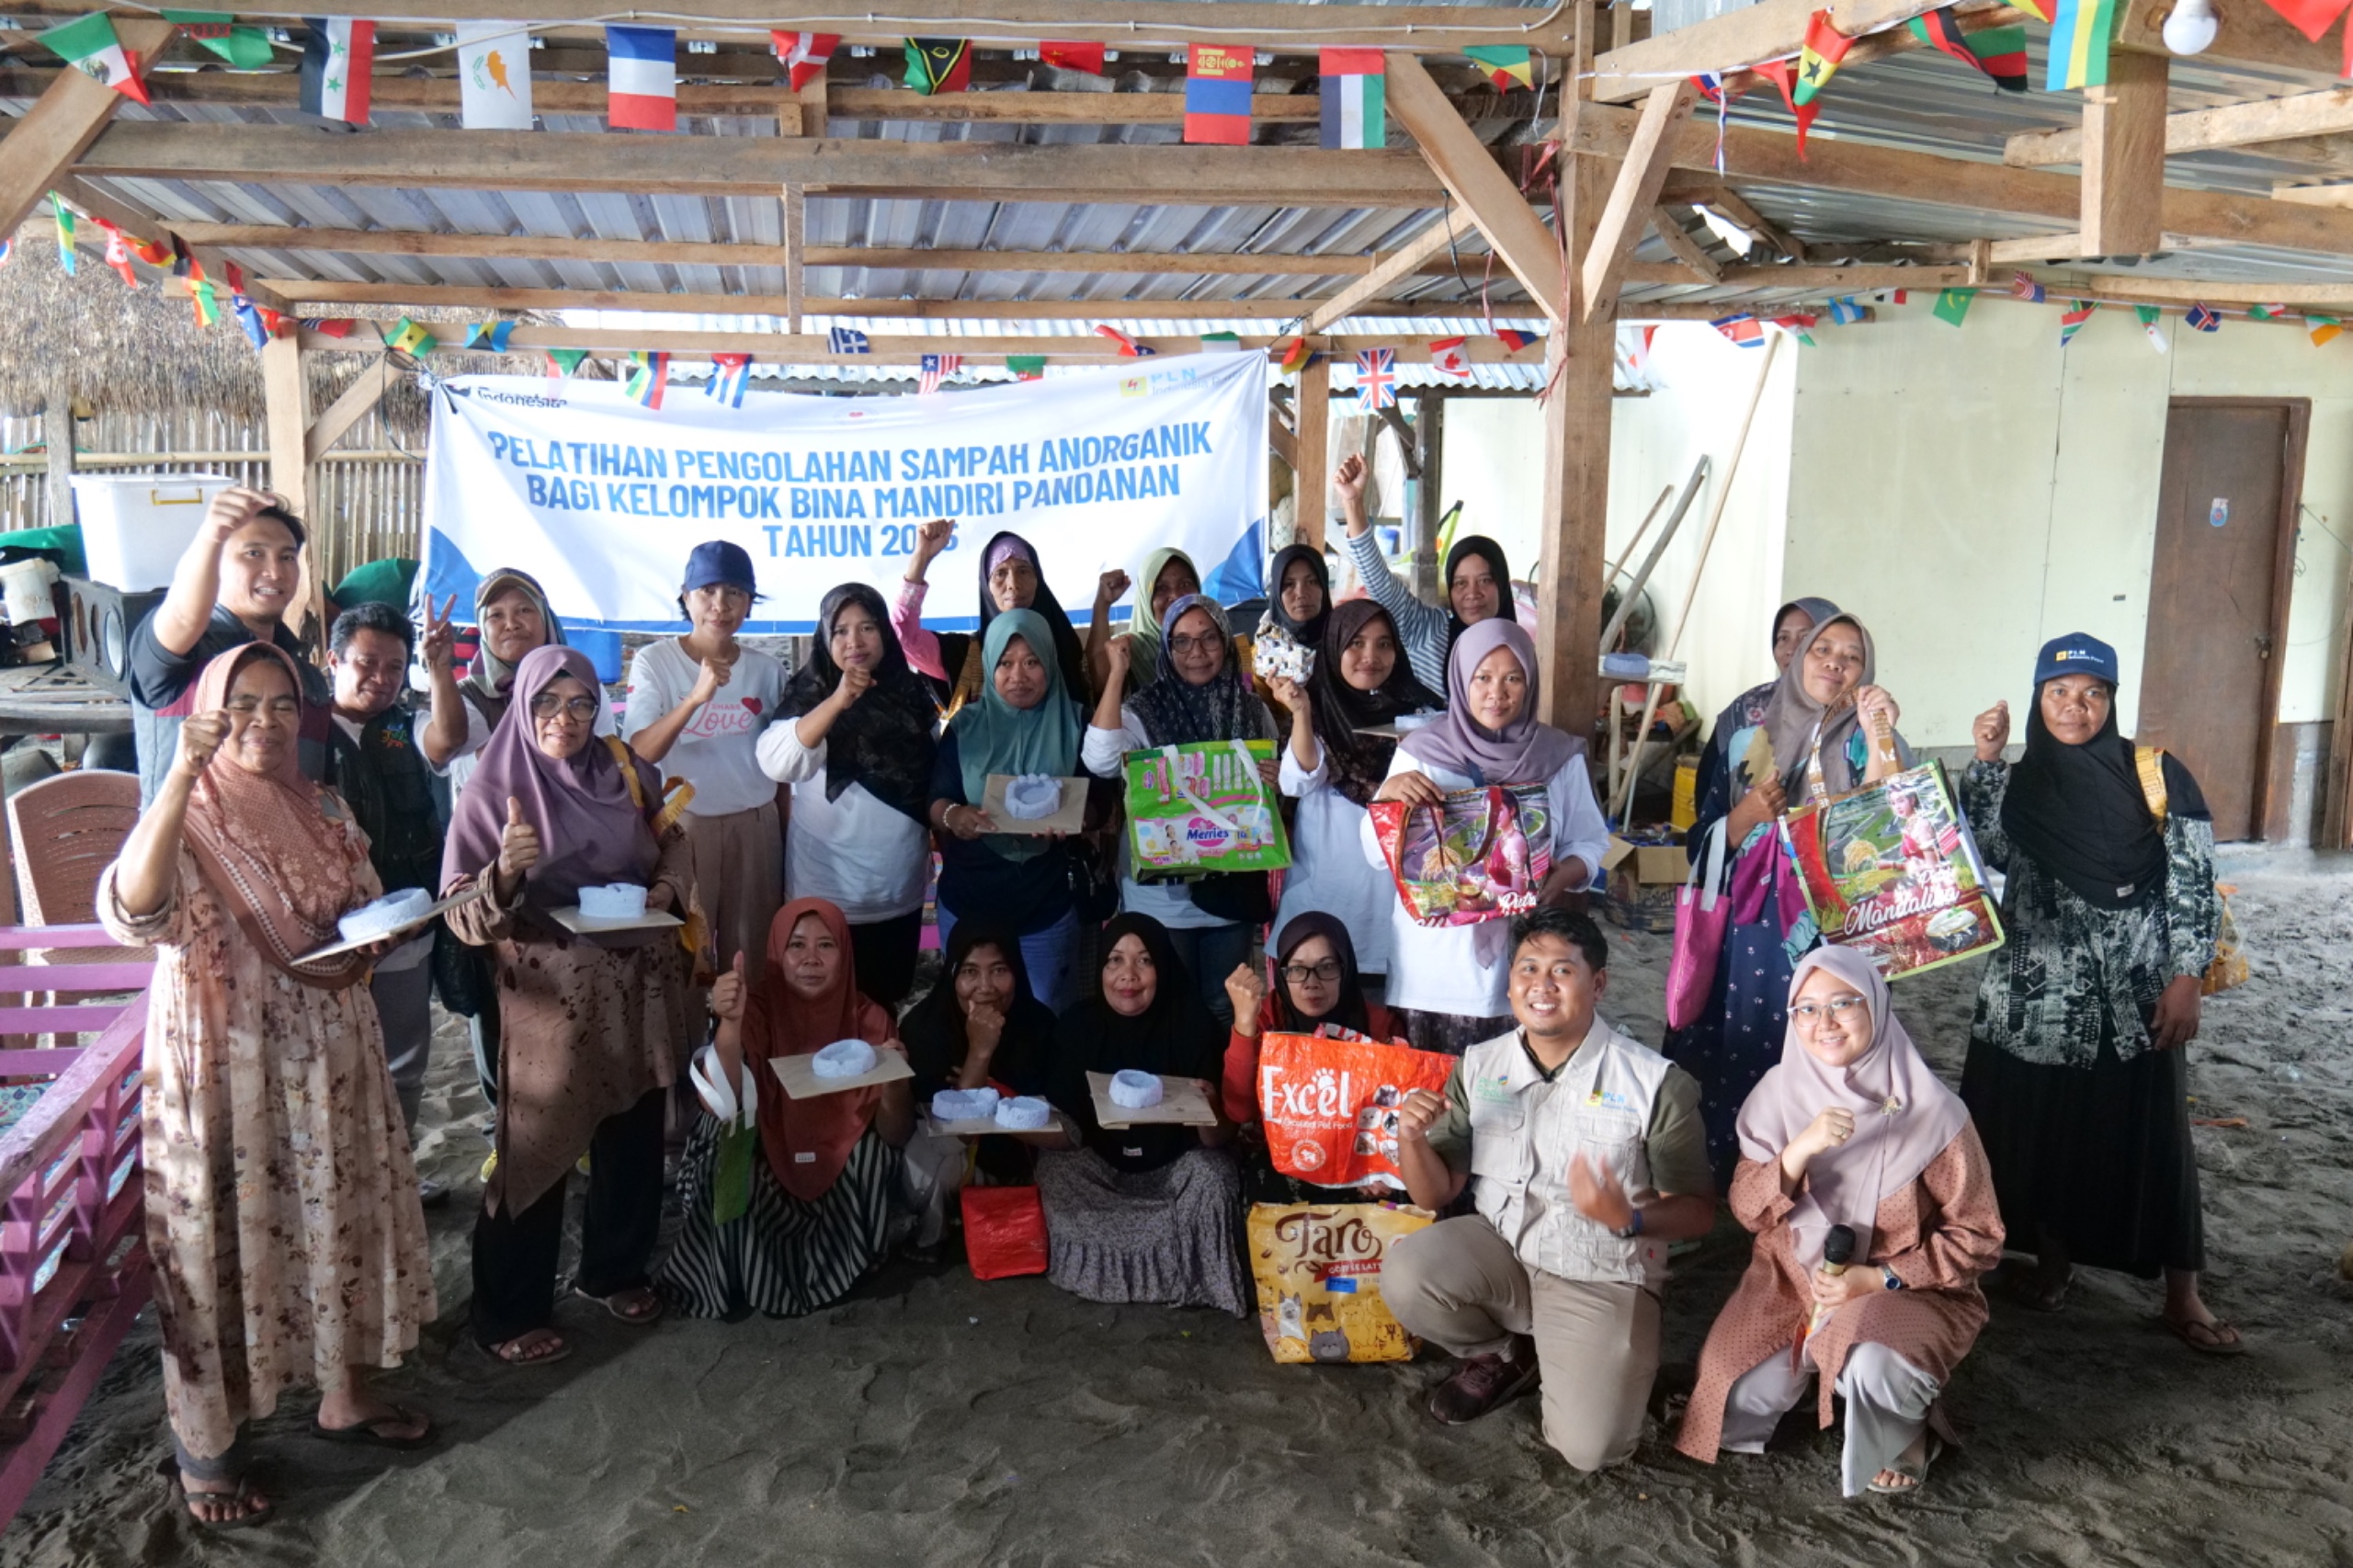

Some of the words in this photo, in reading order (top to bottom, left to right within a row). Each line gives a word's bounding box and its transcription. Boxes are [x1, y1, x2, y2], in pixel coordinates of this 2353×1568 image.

[1151, 368, 1197, 382] PLN
[488, 431, 667, 478] PELATIHAN
[675, 449, 892, 483] PENGOLAHAN
[901, 443, 1029, 481] SAMPAH
[1038, 421, 1212, 472] ANORGANIK
[526, 473, 600, 510] BAGI
[607, 483, 781, 518] KELOMPOK
[790, 486, 867, 518] BINA
[875, 482, 1004, 518] MANDIRI
[1013, 464, 1181, 511] PANDANAN
[762, 525, 872, 557] TAHUN
[682, 700, 754, 737] Love
[1186, 827, 1230, 840] Merries
[1262, 1065, 1353, 1124] Excel
[1275, 1209, 1382, 1261] Taro
[1361, 1262, 1381, 1271] LATT
